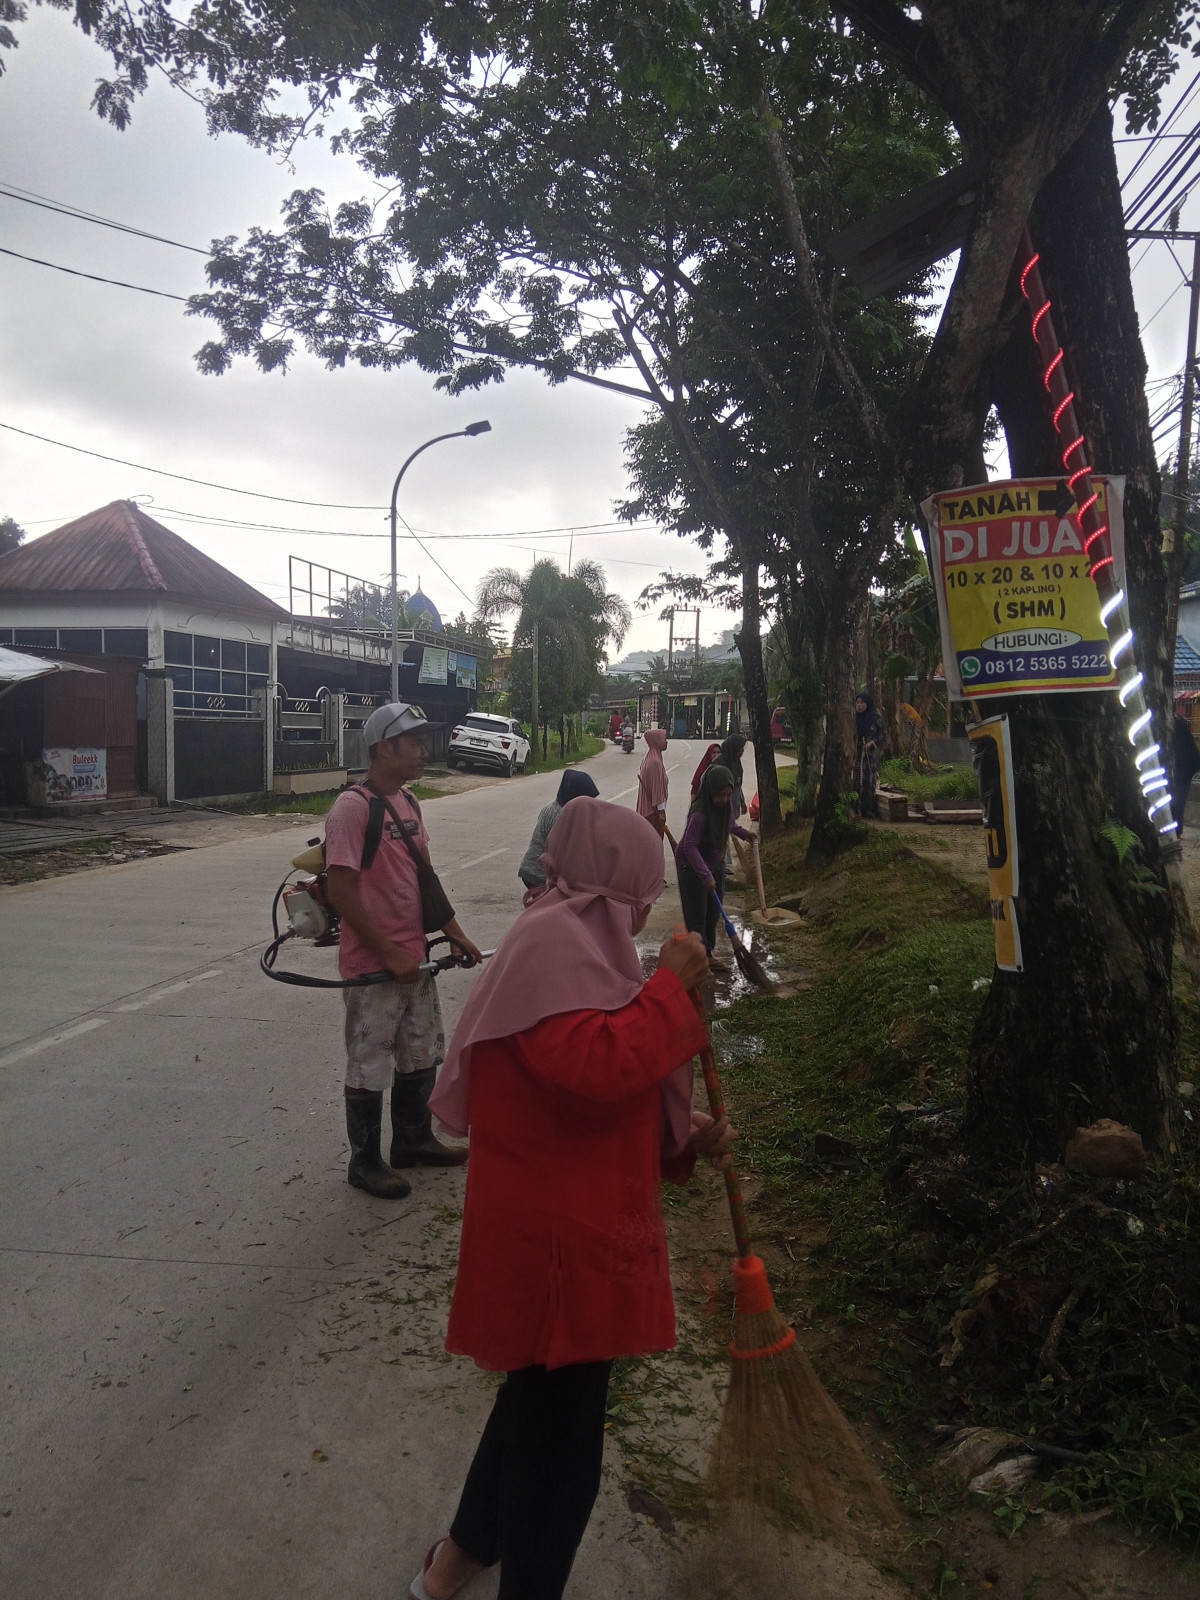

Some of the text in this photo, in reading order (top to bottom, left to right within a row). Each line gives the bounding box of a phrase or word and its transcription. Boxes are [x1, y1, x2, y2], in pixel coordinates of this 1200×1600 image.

[943, 491, 1031, 521] TANAH
[943, 519, 1083, 562] DI JUA
[947, 570, 968, 589] 10
[974, 571, 986, 585] x
[992, 566, 1013, 584] 20
[1020, 565, 1035, 581] &
[1041, 562, 1064, 579] 10
[1069, 564, 1080, 578] x
[1011, 585, 1056, 595] KAPLING
[994, 632, 1068, 649] HUBUNGI:
[985, 654, 1108, 674] 0812 5365 5222
